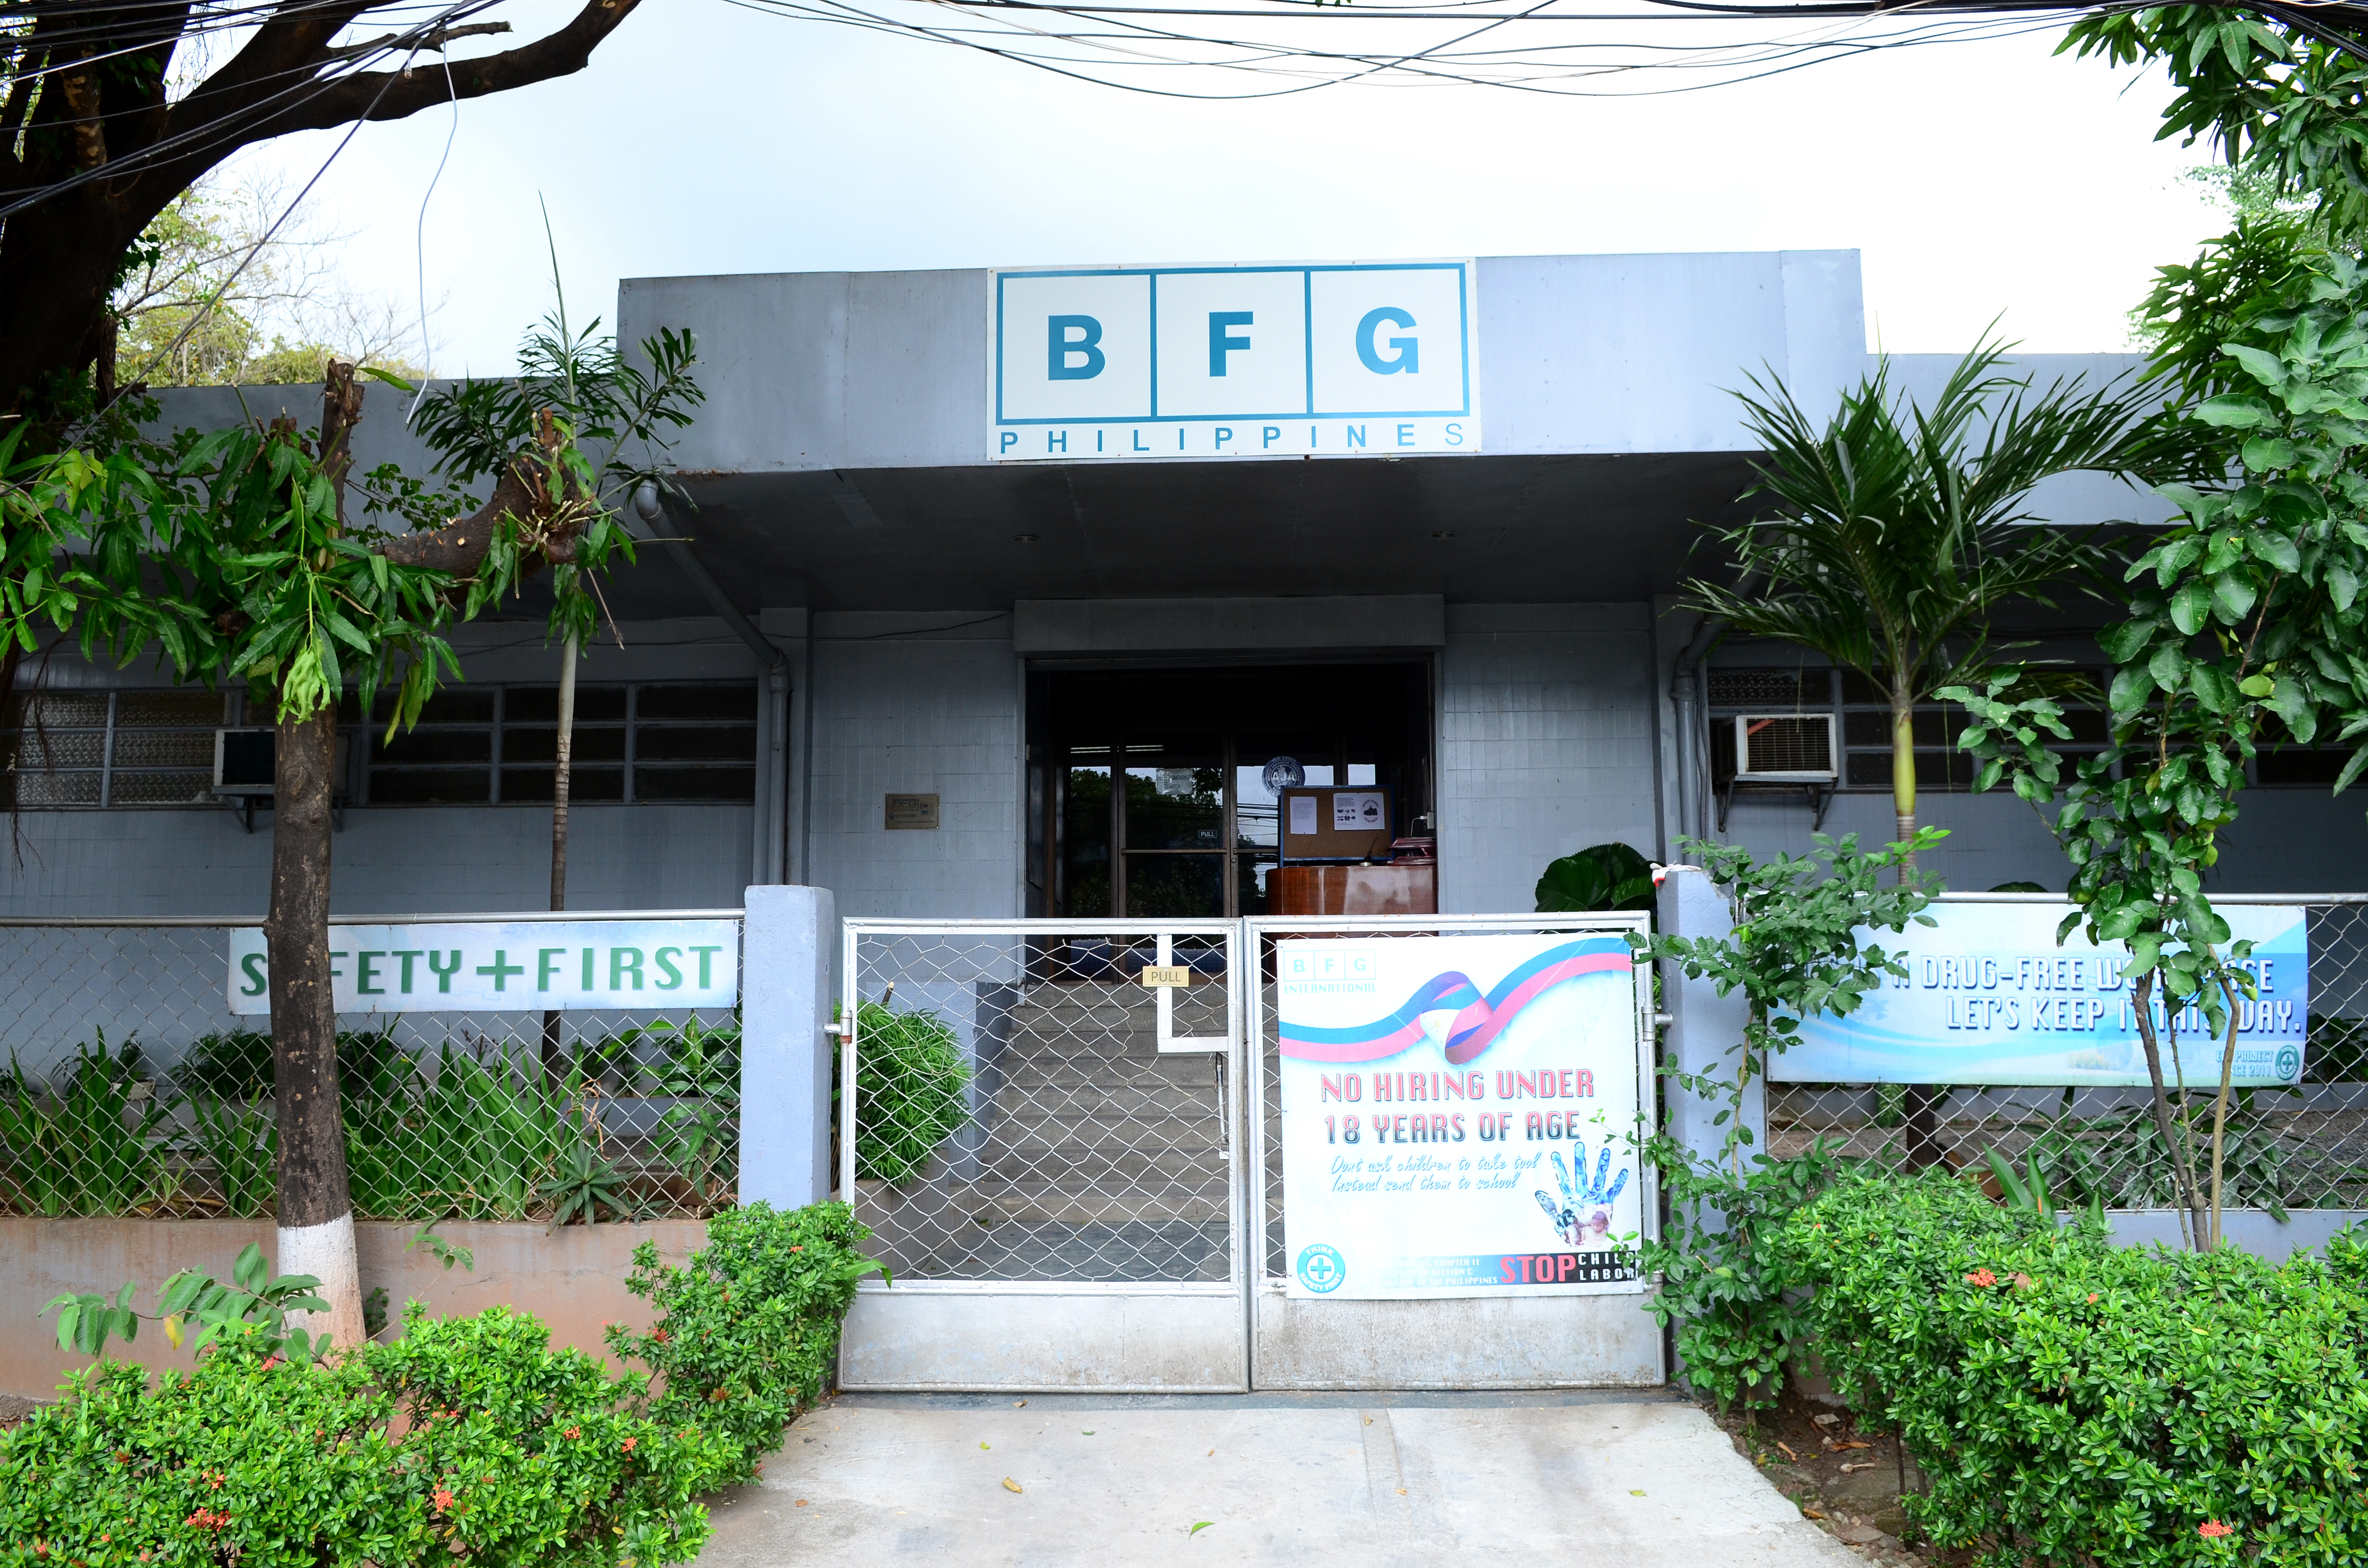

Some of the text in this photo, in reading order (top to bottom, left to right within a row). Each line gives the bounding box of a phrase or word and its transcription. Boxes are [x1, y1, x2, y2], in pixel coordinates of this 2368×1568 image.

[1000, 423, 1464, 454] PHILIPPINES
[1271, 772, 1295, 781] AJA
[240, 950, 462, 996] SETY
[537, 946, 722, 991] FIRST
[1151, 971, 1181, 982] PULL
[1921, 956, 2084, 991] DRUG-FREE
[1284, 983, 1378, 994] INTERNATIONAL
[2031, 997, 2105, 1031] KEEP
[2153, 998, 2212, 1033] THI
[2235, 1050, 2273, 1063] PROJECT
[2249, 1065, 2271, 1077] 2011
[1321, 1069, 1594, 1102] NO HIRING UNDER
[1324, 1110, 1580, 1144] 18 YEARS OF AGE
[1367, 1154, 1393, 1172] ask
[1396, 1154, 1451, 1172] children
[1457, 1156, 1471, 1171] to
[1477, 1152, 1507, 1170] take
[1513, 1151, 1542, 1169] tool
[1332, 1170, 1521, 1192] Instead send them to school
[1305, 1246, 1335, 1256] THINK
[1435, 1259, 1469, 1267] CHAPTER
[1500, 1254, 1576, 1283] STOP
[1432, 1268, 1466, 1276] SECTION
[1579, 1268, 1634, 1281] LABOR
[1299, 1272, 1342, 1290] SAFETY FIRST
[1430, 1277, 1443, 1286] THE
[1445, 1276, 1498, 1285] PHILIPPINES
